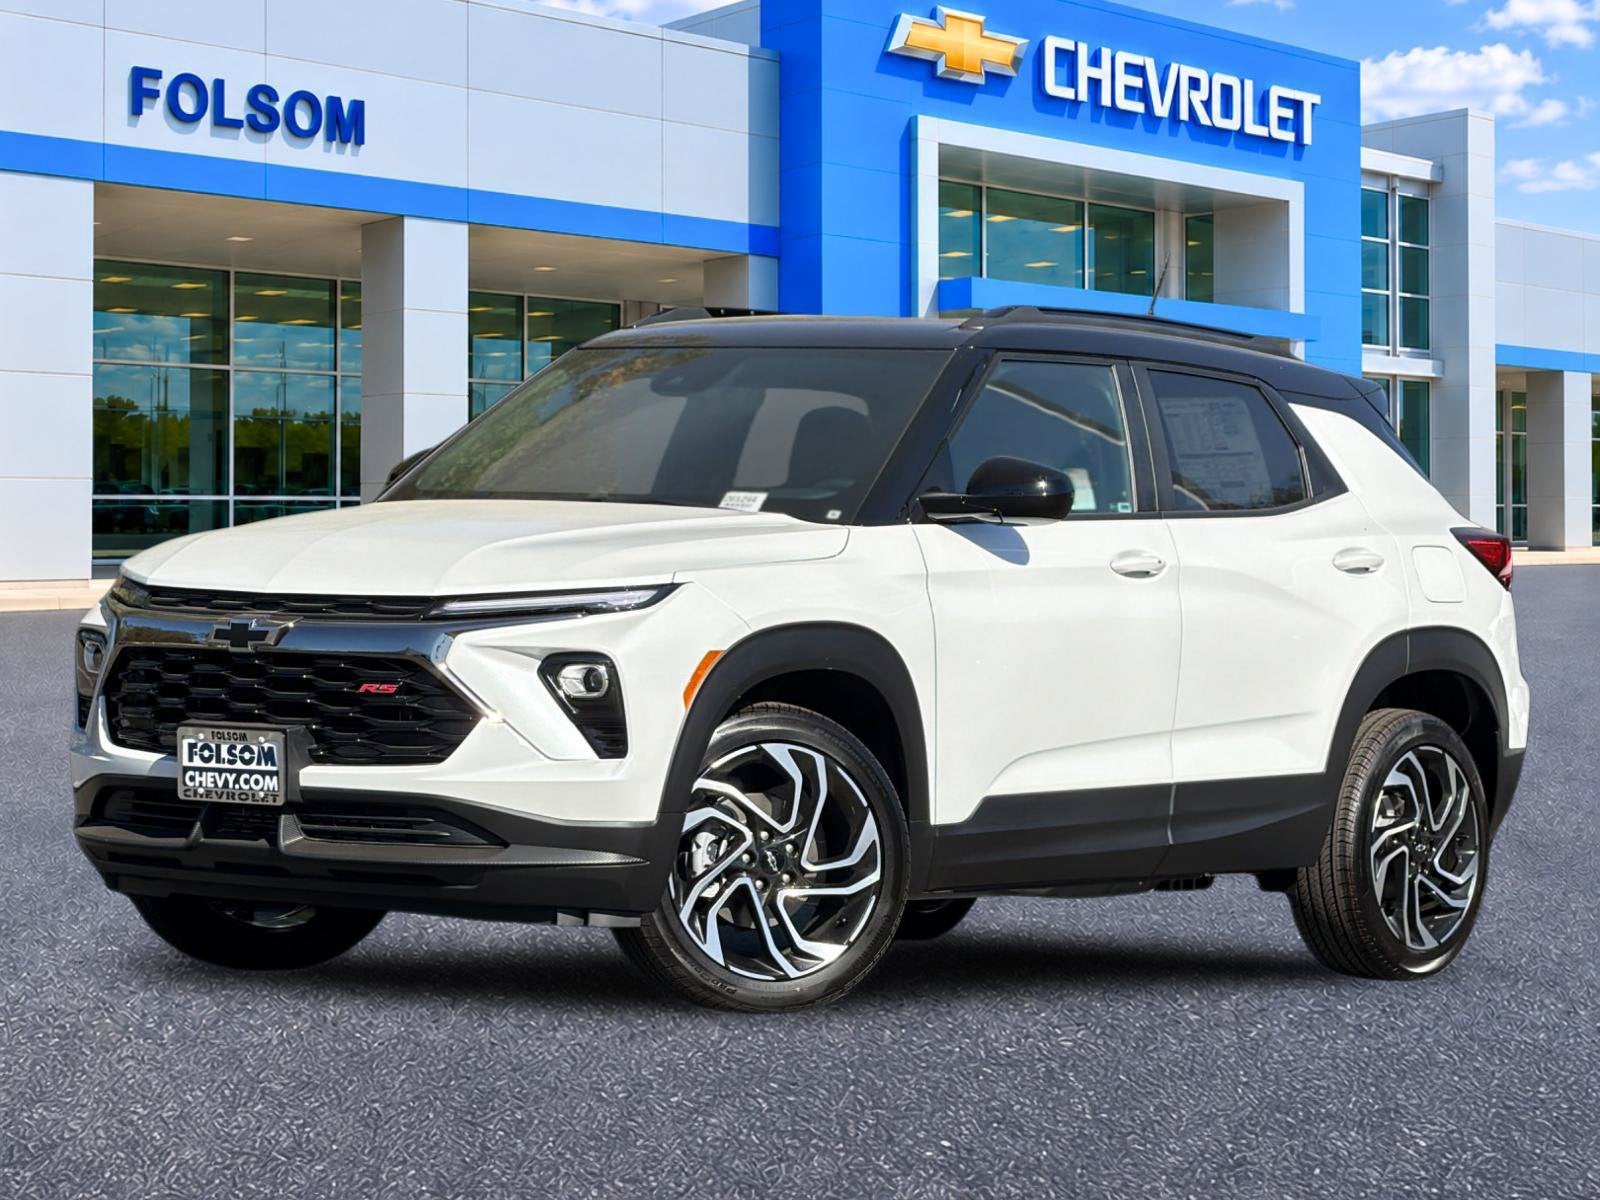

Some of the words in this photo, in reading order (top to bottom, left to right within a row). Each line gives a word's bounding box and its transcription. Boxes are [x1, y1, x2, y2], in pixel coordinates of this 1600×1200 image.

[1044, 35, 1321, 145] CHEVROLET
[129, 65, 366, 146] FOLSOM
[359, 683, 399, 694] RS
[211, 731, 248, 742] FOLSOM
[187, 742, 278, 767] FOLSOM
[184, 770, 279, 792] CHEVY.COM
[183, 788, 279, 803] CHEVROLET
